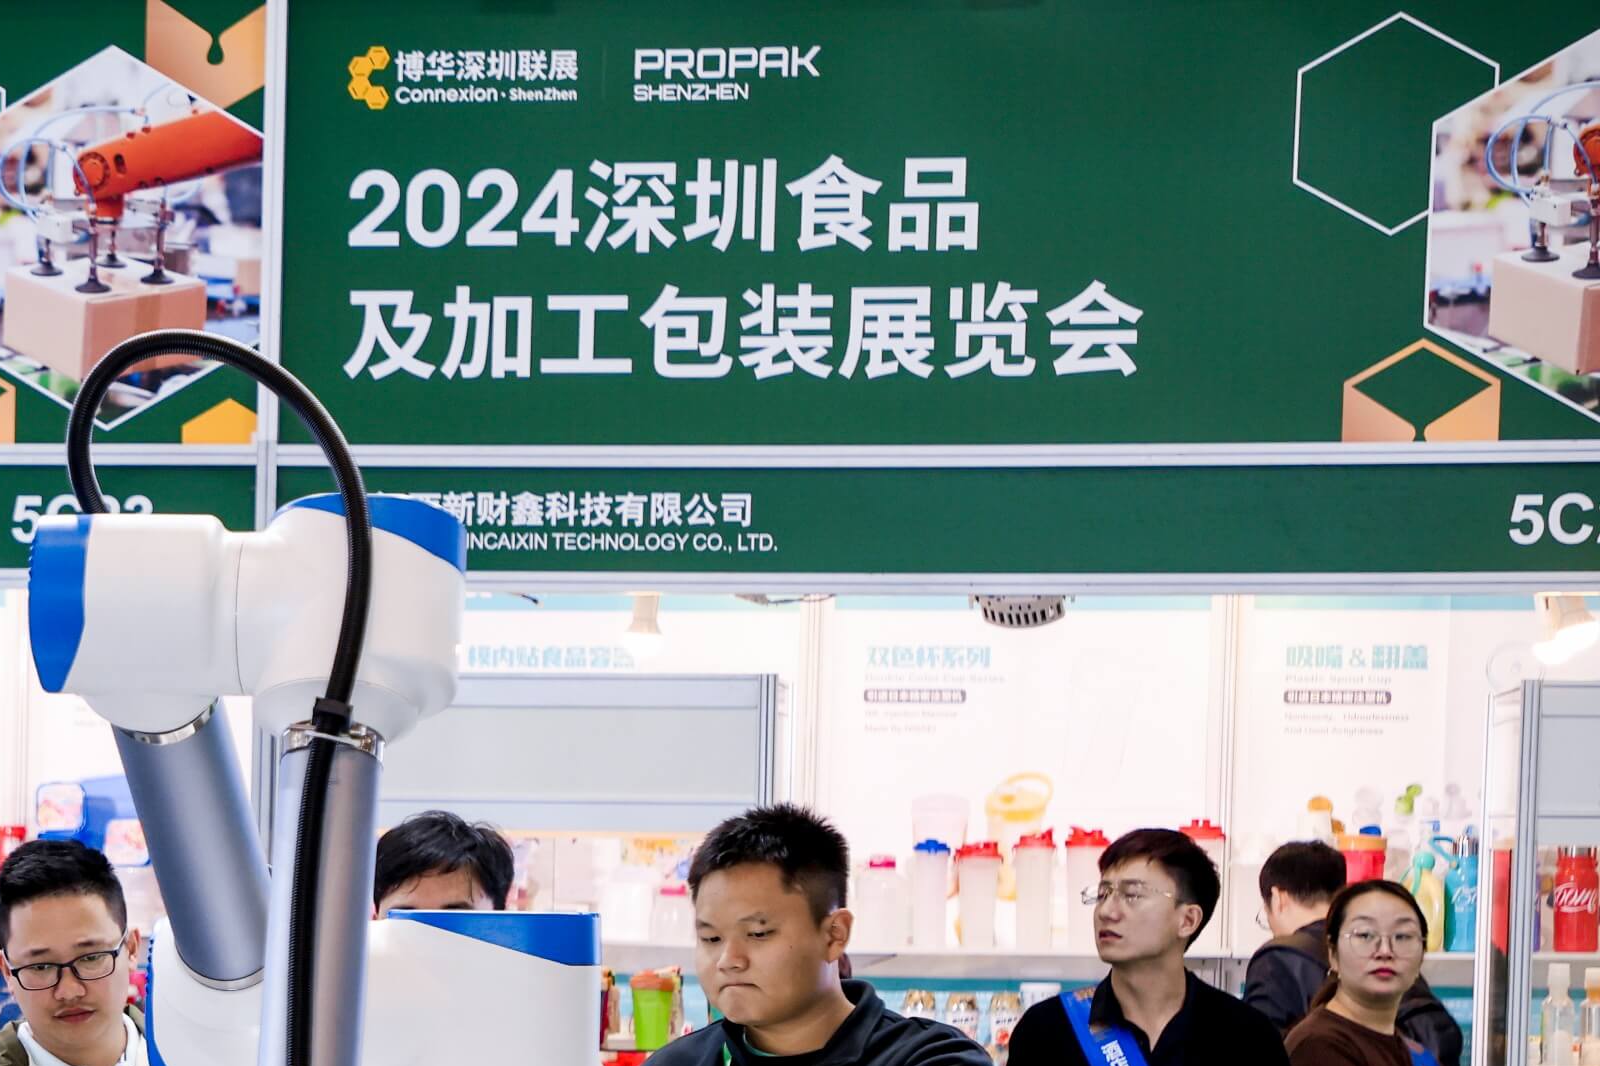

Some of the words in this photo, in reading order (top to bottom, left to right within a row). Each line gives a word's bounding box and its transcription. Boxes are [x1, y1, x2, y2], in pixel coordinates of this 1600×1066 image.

[395, 50, 579, 82] 博华深圳联展
[634, 45, 821, 79] PROPAK
[395, 85, 499, 104] Connexion
[508, 87, 578, 102] ShenZhen
[634, 83, 750, 102] SHENZHEN
[348, 154, 980, 254] 2024深圳食品
[342, 279, 1145, 380] 及加工包装展览会
[405, 490, 753, 528] 新财鑫科技有限公司
[1508, 492, 1600, 546] 5C
[464, 532, 548, 550] INCAIXIN
[552, 532, 689, 552] TECHNOLOGY
[692, 533, 733, 553] CO.,
[737, 533, 778, 551] LTD.
